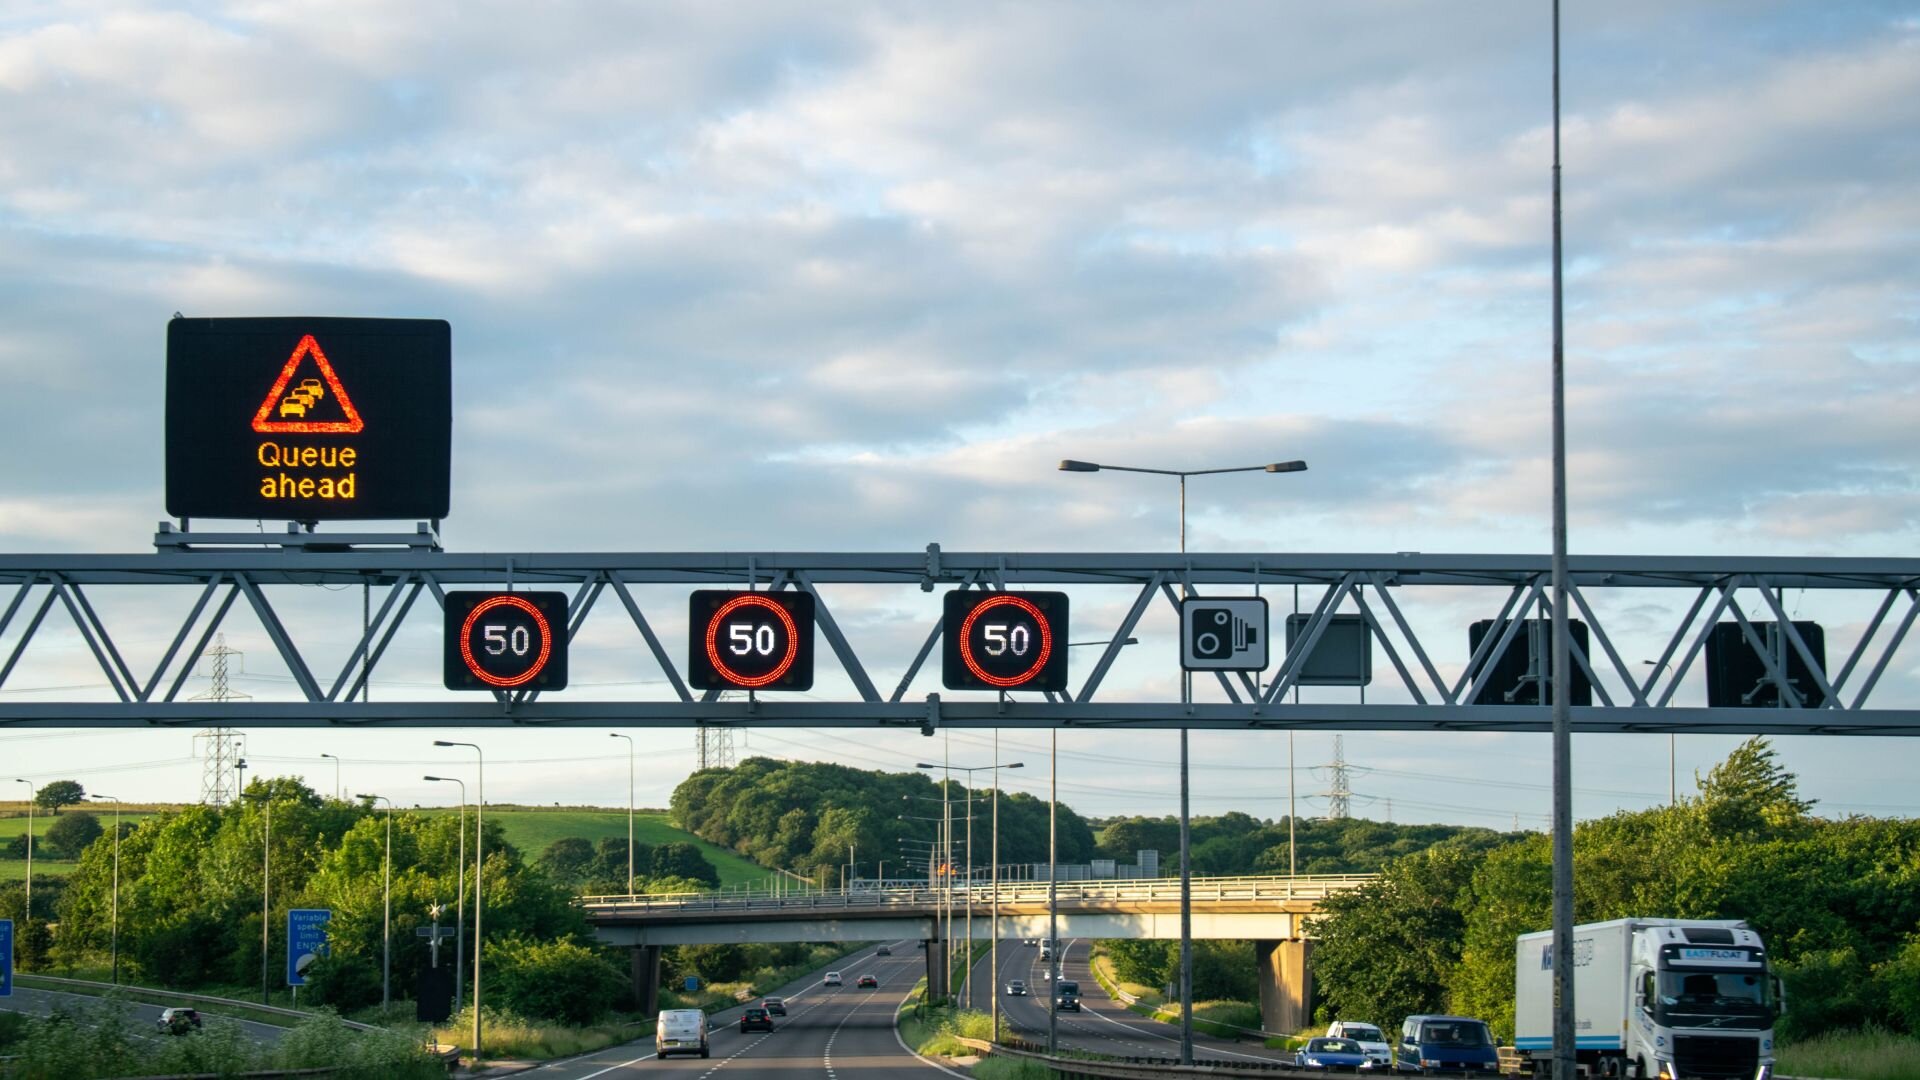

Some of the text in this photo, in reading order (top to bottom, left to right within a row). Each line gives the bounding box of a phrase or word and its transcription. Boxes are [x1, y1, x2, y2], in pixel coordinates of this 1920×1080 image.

[258, 442, 357, 467] Queue
[260, 472, 355, 498] ahead
[484, 625, 530, 656] 50
[729, 625, 775, 656] 50
[984, 625, 1030, 656] 50
